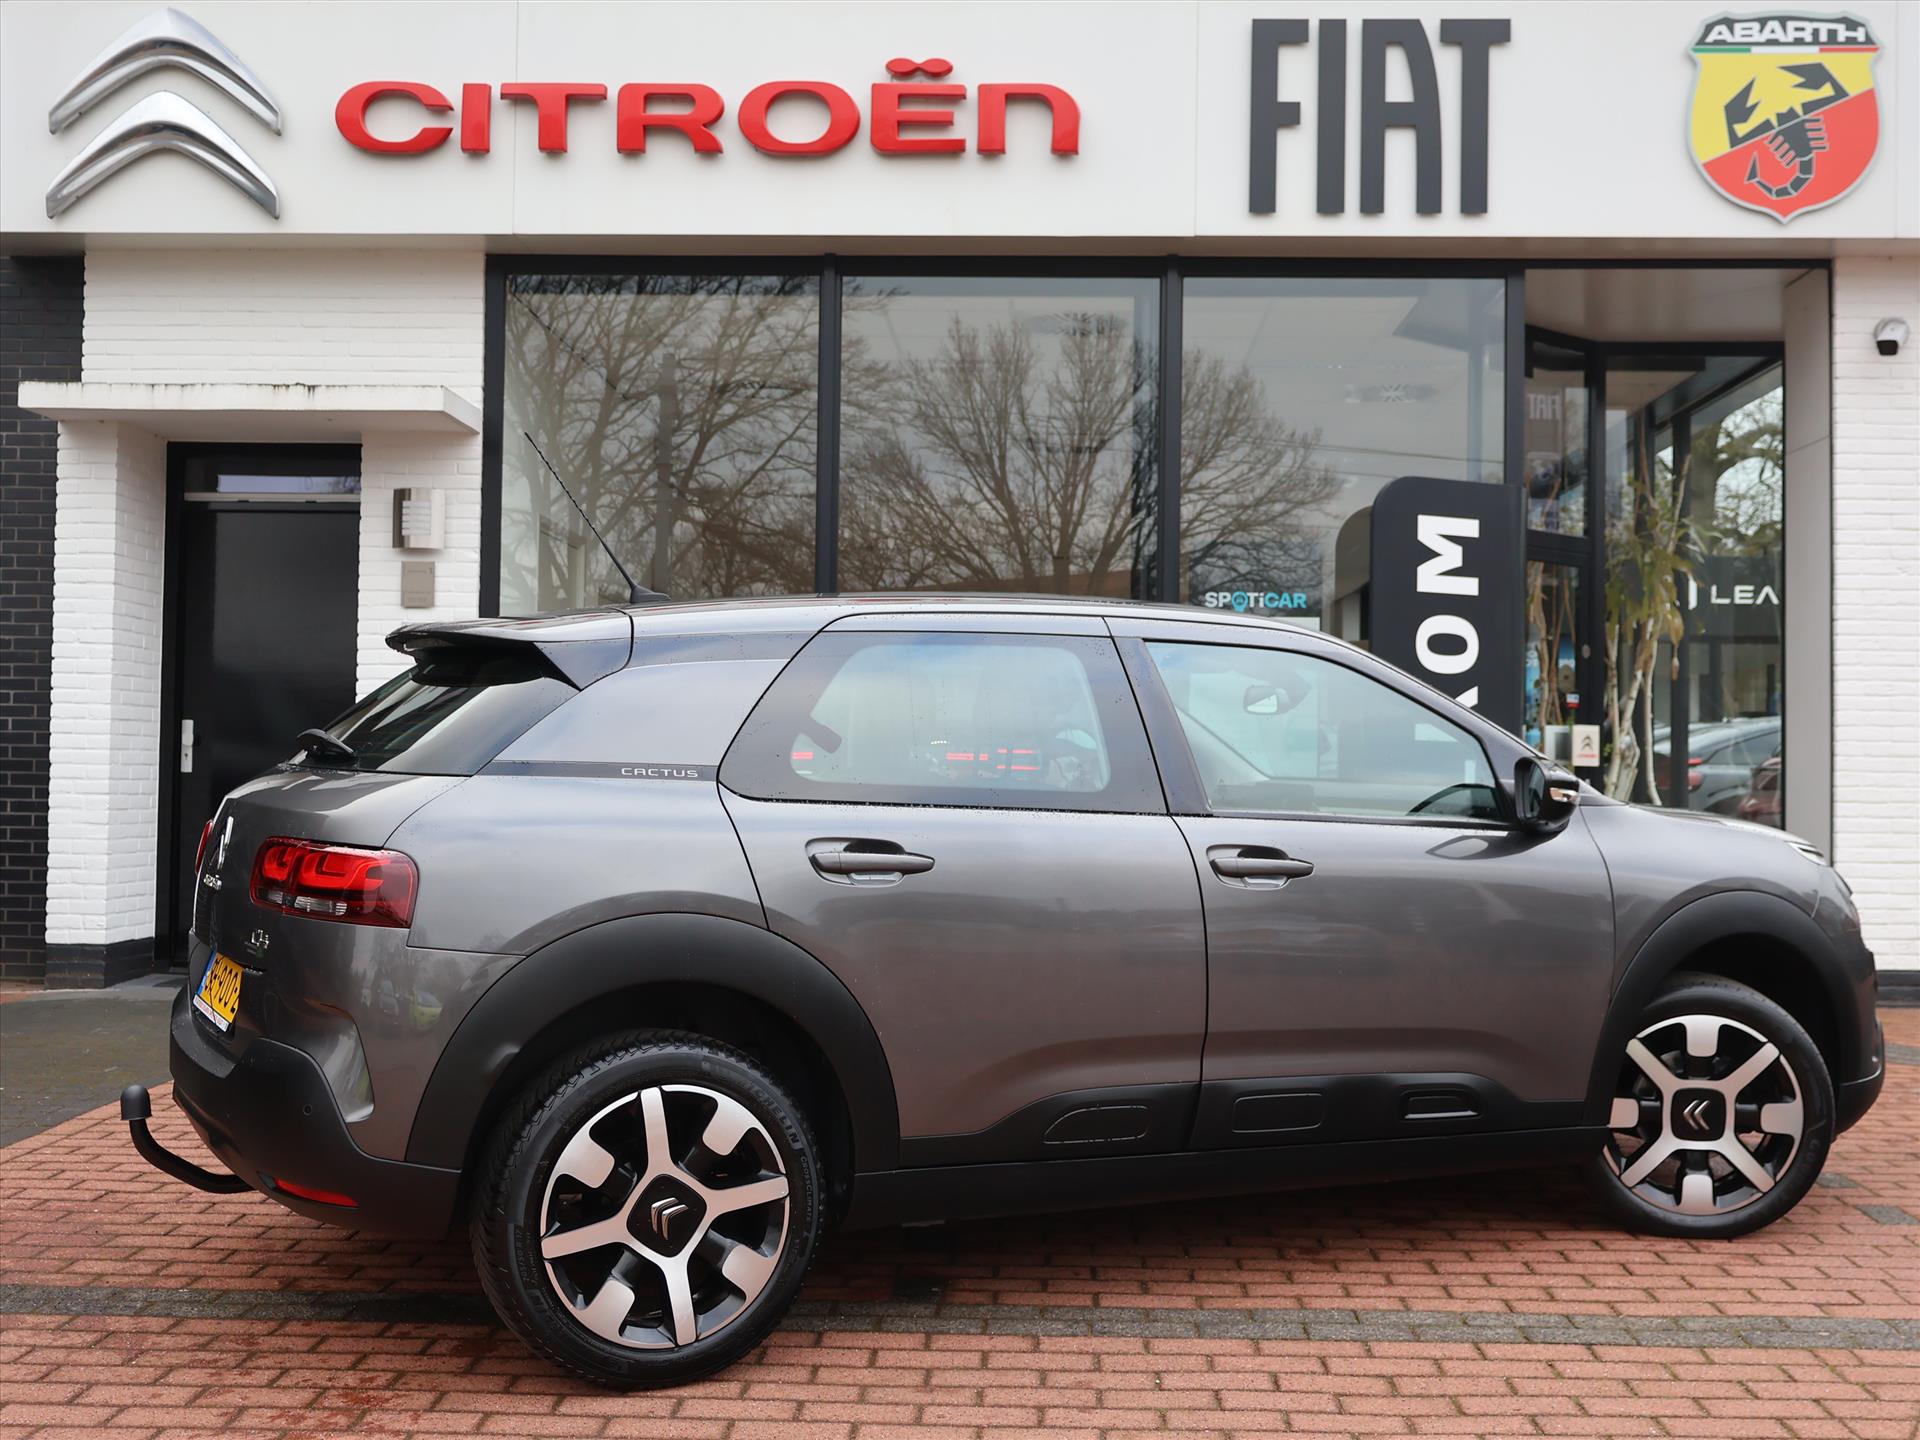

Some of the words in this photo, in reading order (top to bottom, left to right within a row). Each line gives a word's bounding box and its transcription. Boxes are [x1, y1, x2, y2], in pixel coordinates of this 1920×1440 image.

[1703, 20, 1867, 44] ABARTH
[334, 58, 1082, 156] CITROËN
[1249, 18, 1512, 215] FIAT
[1710, 584, 1780, 605] LEA
[621, 767, 698, 778] CACTUS
